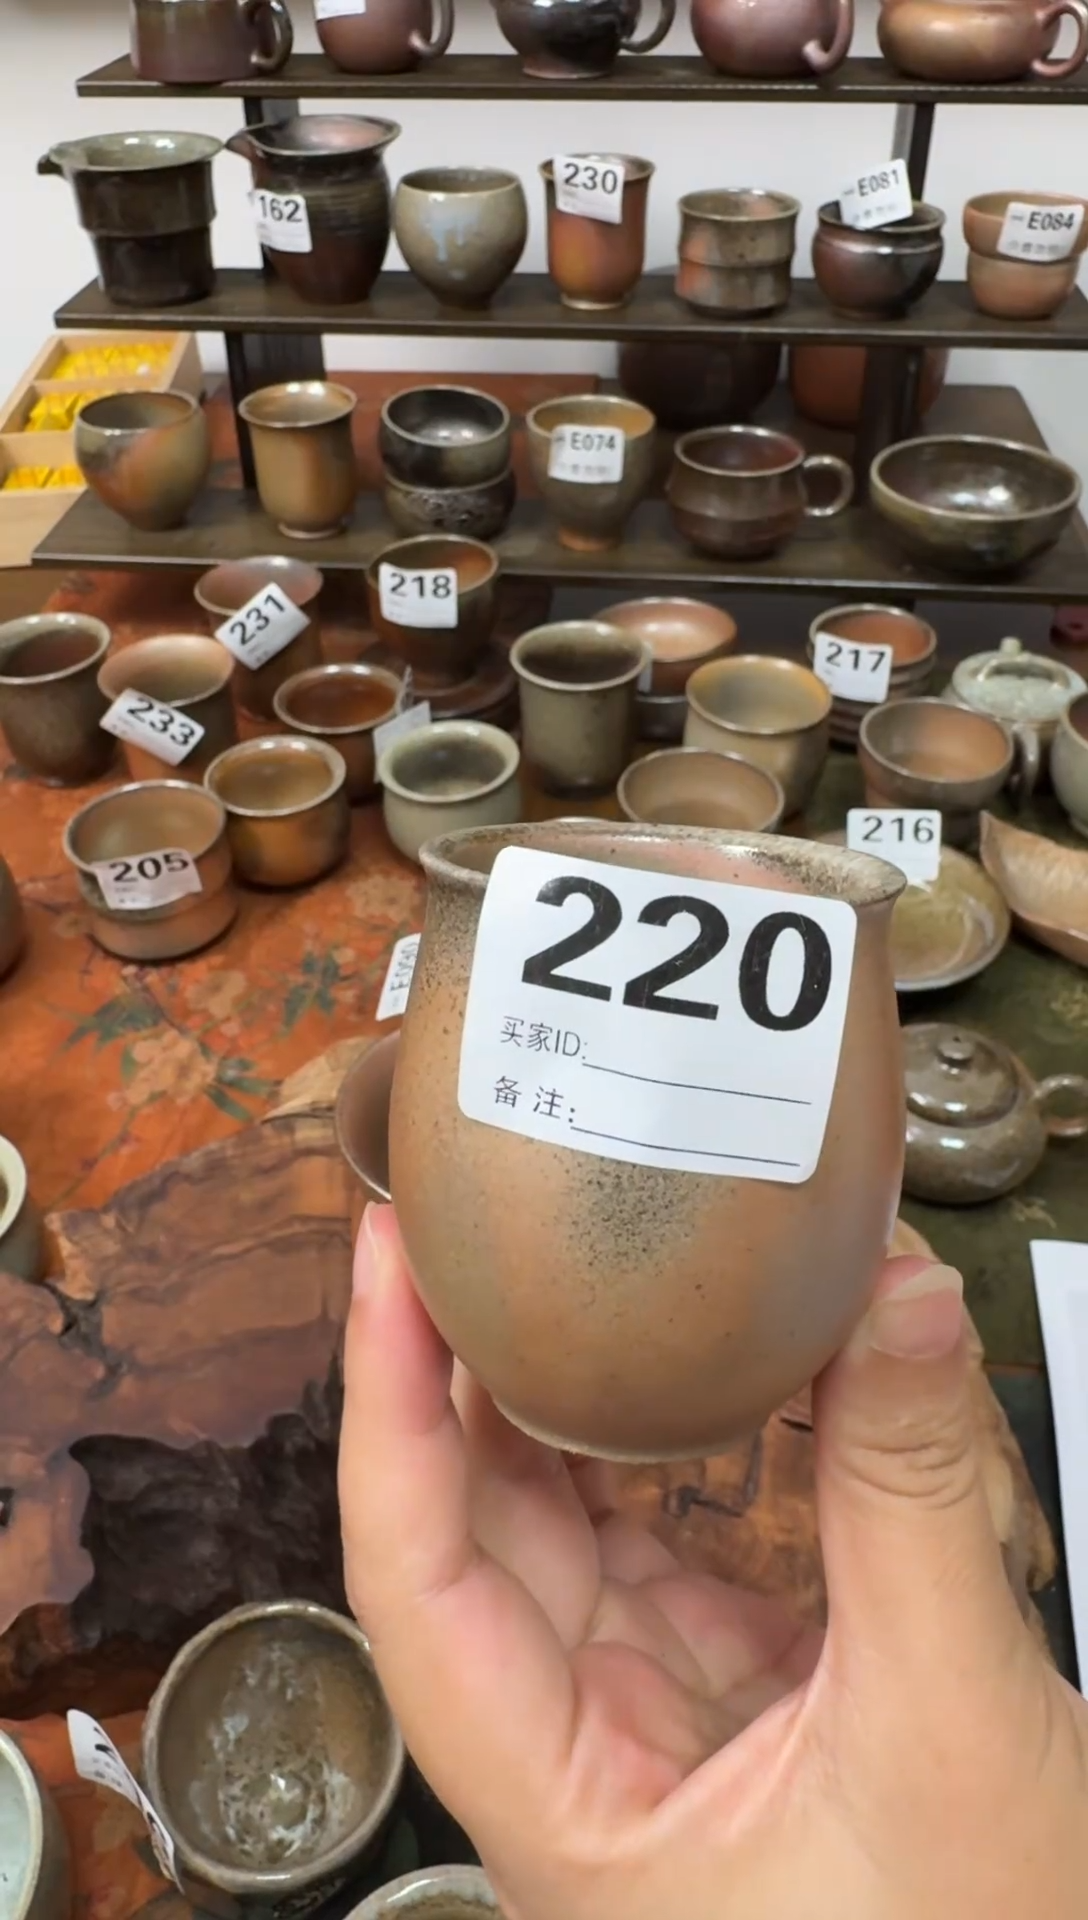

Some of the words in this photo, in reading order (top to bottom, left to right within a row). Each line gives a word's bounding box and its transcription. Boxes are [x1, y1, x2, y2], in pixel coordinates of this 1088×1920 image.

[564, 162, 618, 194] 230
[857, 168, 899, 197] E081
[1027, 211, 1075, 231] E084
[571, 431, 616, 452] E074
[390, 572, 451, 599] 218
[229, 594, 285, 646] 231
[825, 642, 886, 673] 217
[126, 697, 195, 746] 233
[861, 815, 934, 844] 216
[109, 852, 189, 882] 205
[521, 876, 832, 1031] 220
[499, 1015, 588, 1060] 买家ID:
